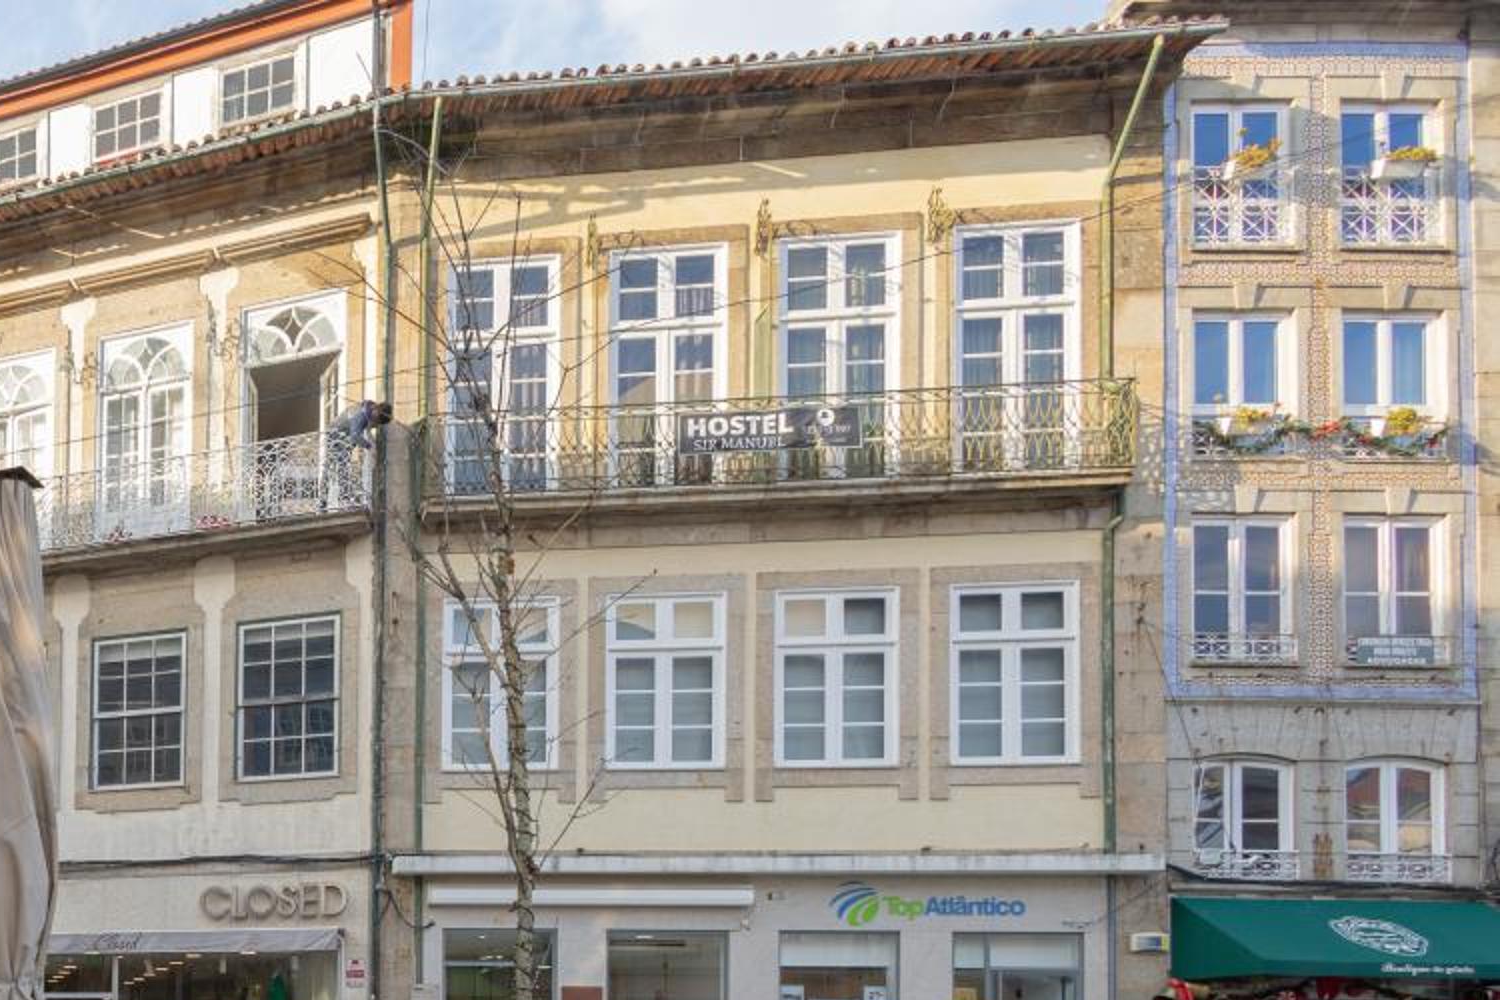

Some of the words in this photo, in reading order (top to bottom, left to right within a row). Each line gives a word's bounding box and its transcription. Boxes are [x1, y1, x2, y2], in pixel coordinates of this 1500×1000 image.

[686, 412, 795, 437] HOSTEL
[693, 438, 718, 451] SIR
[720, 436, 787, 450] MANUEL
[199, 885, 348, 921] CLOSED
